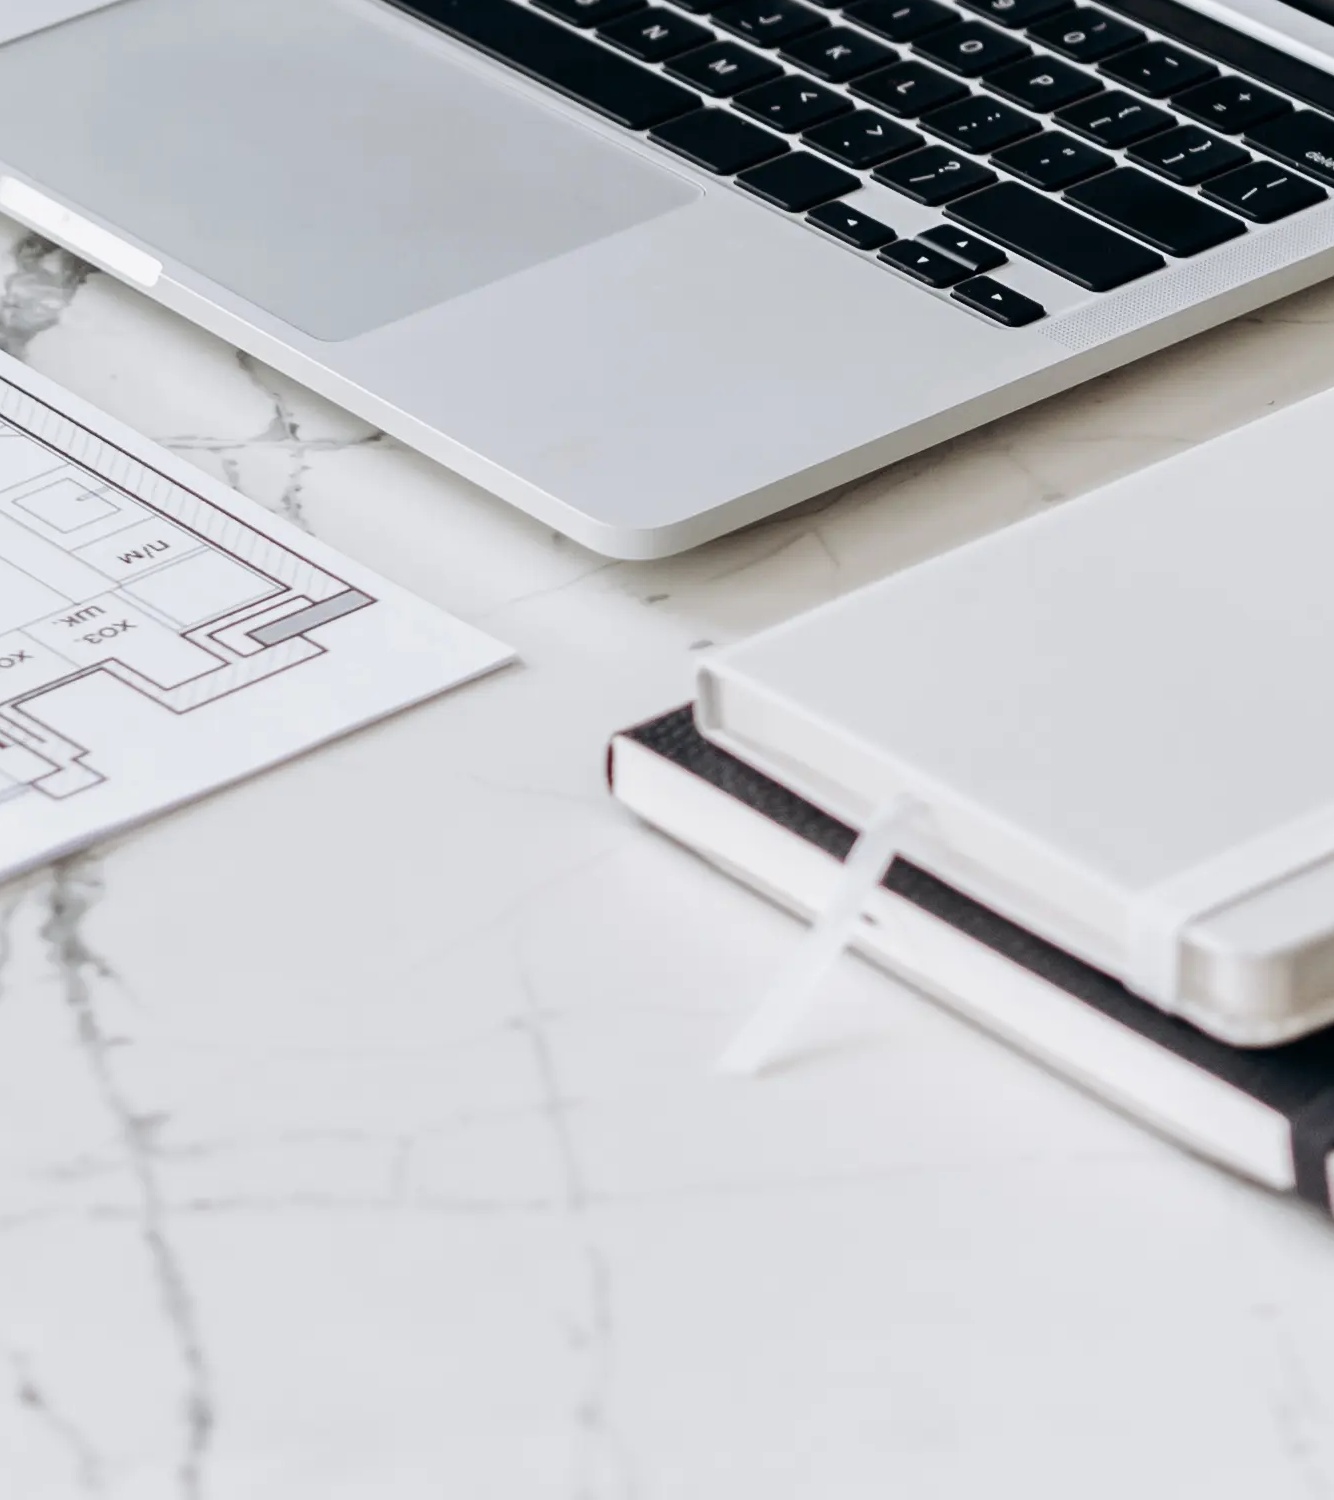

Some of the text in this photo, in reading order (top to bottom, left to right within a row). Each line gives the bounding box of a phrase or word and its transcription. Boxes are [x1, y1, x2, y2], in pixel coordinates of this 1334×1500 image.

[643, 25, 668, 40] N
[709, 59, 737, 75] M
[1064, 31, 1085, 43] 0
[826, 45, 851, 59] K
[897, 81, 915, 93] L
[960, 40, 983, 53] O
[1030, 74, 1054, 86] P
